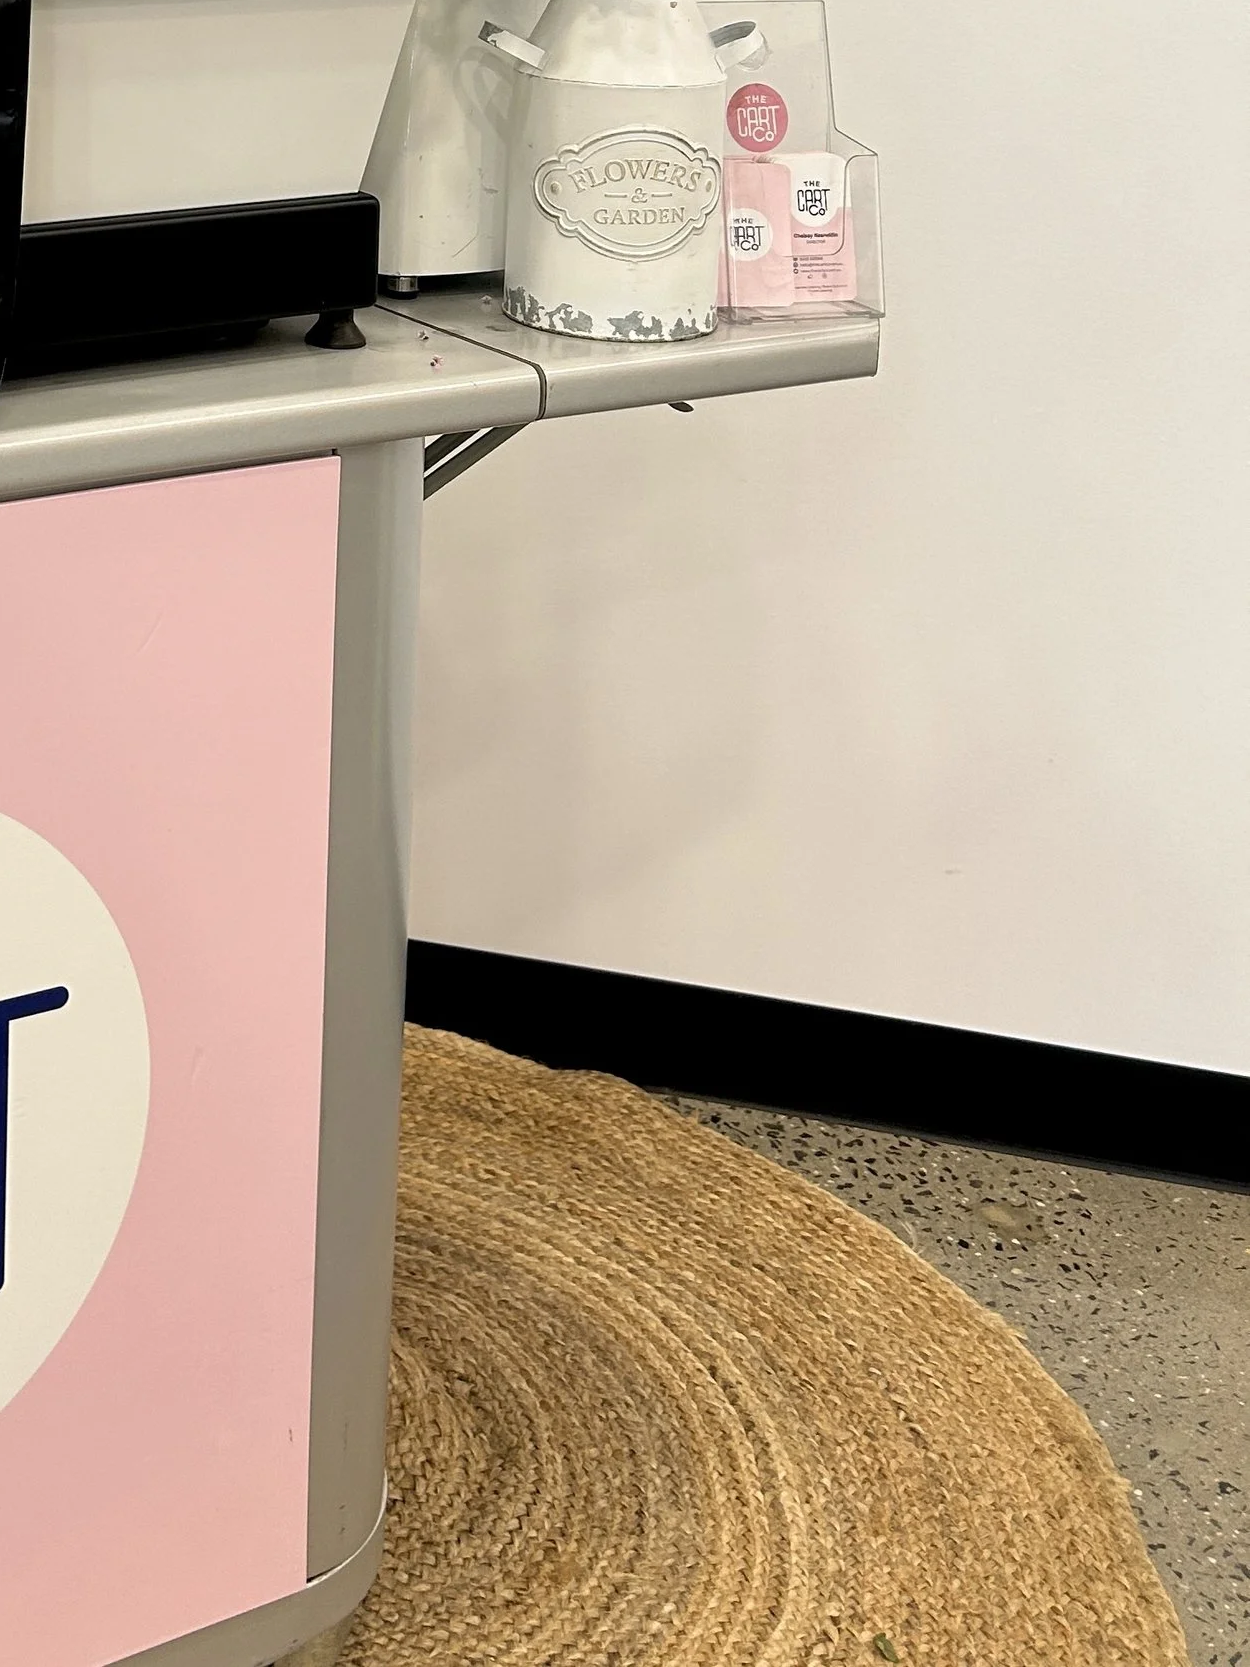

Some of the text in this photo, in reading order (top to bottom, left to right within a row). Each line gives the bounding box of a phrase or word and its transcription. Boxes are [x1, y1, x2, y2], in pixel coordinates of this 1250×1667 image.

[744, 94, 767, 104] THE
[736, 105, 780, 137] CART
[752, 126, 775, 142] Co
[568, 159, 702, 194] FLOWERS
[631, 187, 649, 204] &
[796, 188, 831, 212] CART
[593, 207, 686, 226] GARDEN
[808, 204, 826, 216] Co
